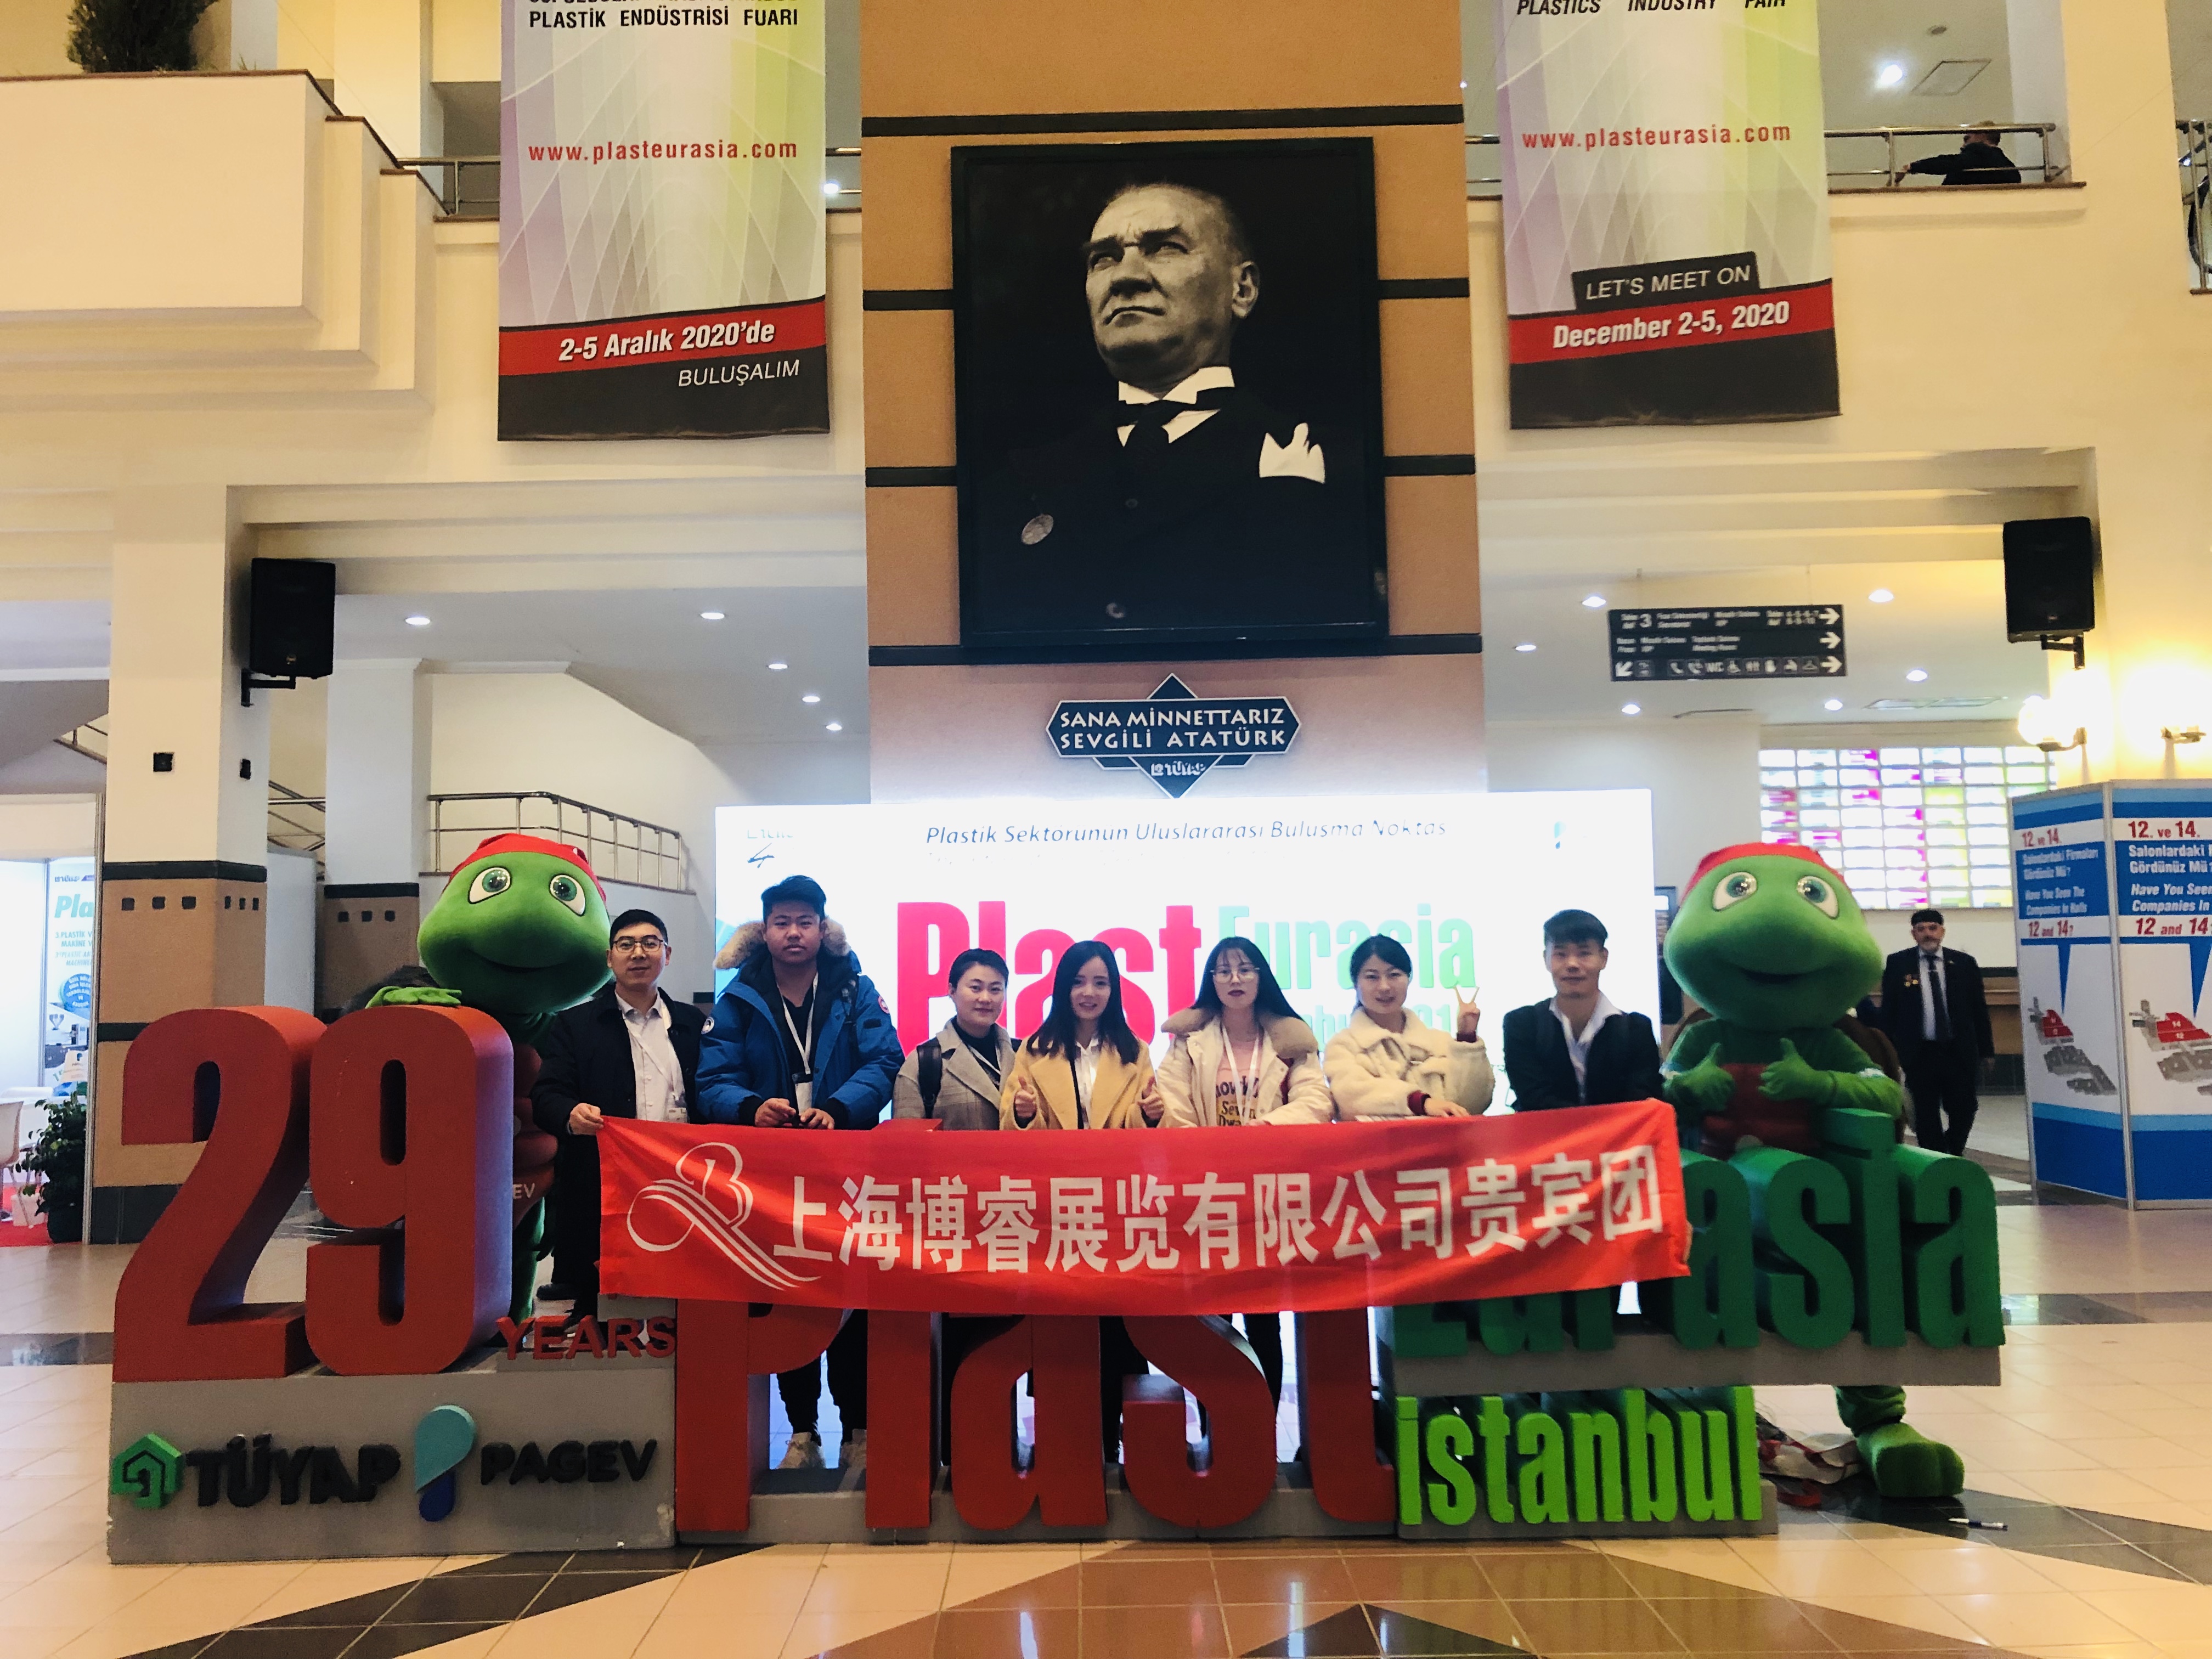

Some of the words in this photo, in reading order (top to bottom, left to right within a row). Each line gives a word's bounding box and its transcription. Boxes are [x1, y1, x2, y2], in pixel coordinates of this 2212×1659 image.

[529, 8, 606, 28] PLASTİK
[620, 5, 729, 26] ENDÜSTRİSİ
[744, 9, 798, 26] FUARI
[1517, 0, 1600, 15] PLASTICS
[1522, 124, 1791, 151] www.plasteurasia.com
[528, 139, 797, 165] www.plasteurasia.com
[1585, 277, 1644, 300] LET'S
[1651, 269, 1710, 292] MEET
[1717, 266, 1750, 285] ON
[1553, 315, 1672, 349] December
[1678, 310, 1723, 336] 2-5,
[1731, 301, 1790, 328] 2020
[558, 335, 597, 362] 2-5
[605, 328, 673, 358] Aralık
[680, 320, 776, 351] 2020'de
[678, 359, 800, 387] BULUŞALIM
[1060, 712, 1121, 728] SANA
[1126, 707, 1285, 727] MİNNETTARIZ
[1060, 729, 1152, 749] SEVGİLİ
[1166, 727, 1285, 748] ATATÜRK
[926, 825, 997, 844] Plastik
[1136, 822, 1263, 840] Uluslararası
[2157, 828, 2171, 838] ve
[2175, 820, 2200, 838] 14.
[2129, 844, 2205, 858] Salonlardaki
[2130, 860, 2186, 873] Gördünüz
[2131, 883, 2159, 896] Have
[2164, 883, 2184, 895] You
[54, 894, 94, 918] Pla
[2132, 899, 2196, 915] Companies
[2198, 899, 2210, 911] In
[2028, 921, 2040, 937] 12
[2136, 917, 2156, 935] 12
[2160, 924, 2182, 935] and
[2189, 917, 2212, 935] 14
[112, 1007, 513, 1383] 29
[772, 1145, 1663, 1274] 上海博睿展览有限公司贵宾团
[496, 1316, 678, 1361] YEARS
[185, 1432, 402, 1508] TÜYAP
[480, 1437, 658, 1486] PAGEV
